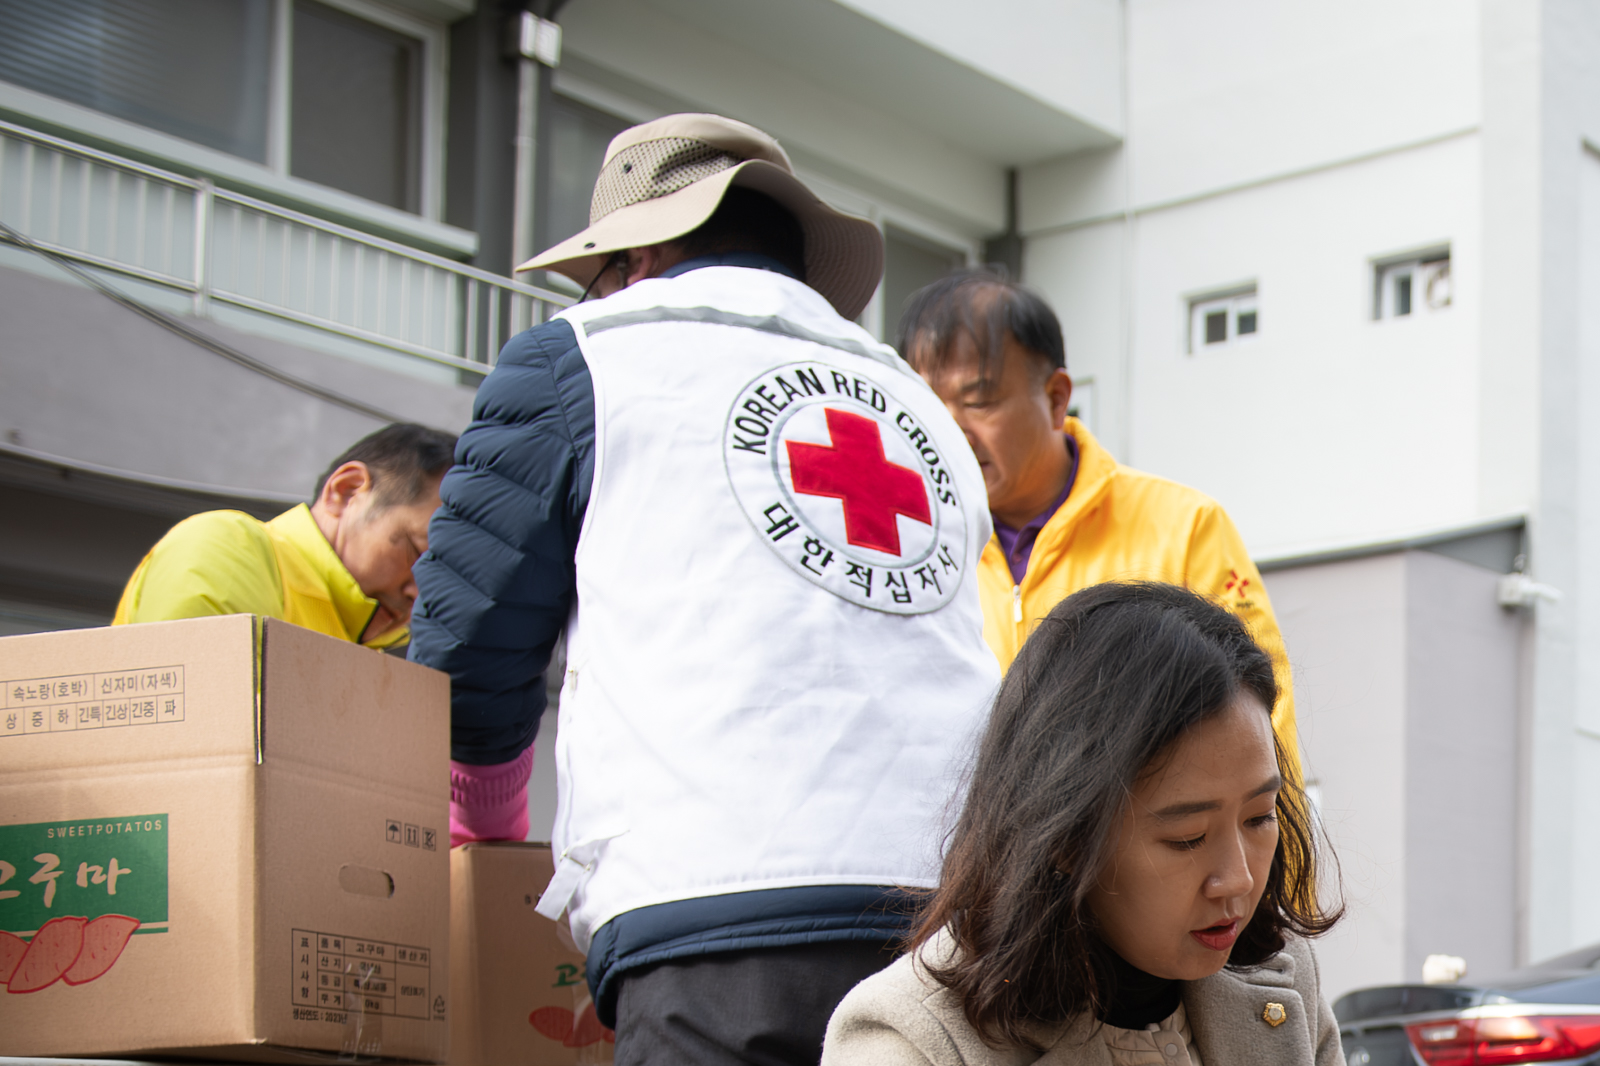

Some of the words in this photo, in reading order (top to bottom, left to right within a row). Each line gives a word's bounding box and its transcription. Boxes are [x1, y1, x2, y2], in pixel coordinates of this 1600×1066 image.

[733, 367, 826, 456] KOREAN
[830, 370, 887, 414] RED
[895, 411, 957, 507] CROSS
[762, 502, 959, 604] 대한적십자사
[47, 819, 163, 839] SWEETPOTATOS
